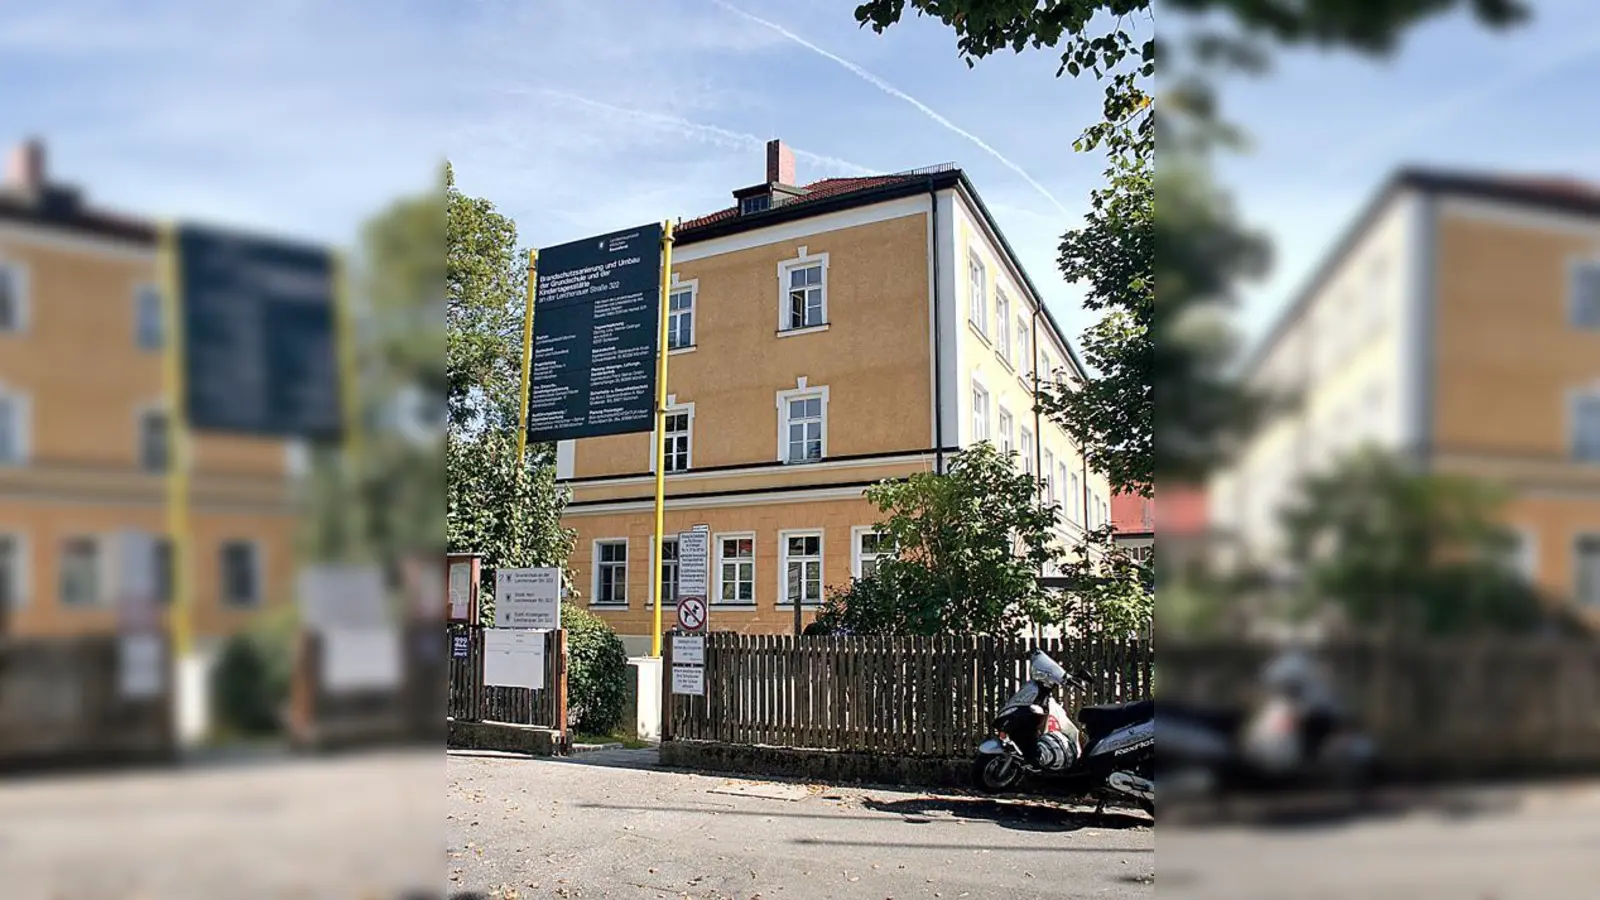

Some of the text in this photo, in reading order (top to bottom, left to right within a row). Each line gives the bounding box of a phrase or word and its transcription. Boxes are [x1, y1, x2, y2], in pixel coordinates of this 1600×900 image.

[540, 257, 640, 282] Brandschutzsanierung und Umbau
[539, 281, 590, 296] Kindertagesstätte
[540, 269, 611, 291] der Grundschule und der
[590, 284, 608, 294] Straße
[609, 281, 620, 290] 322
